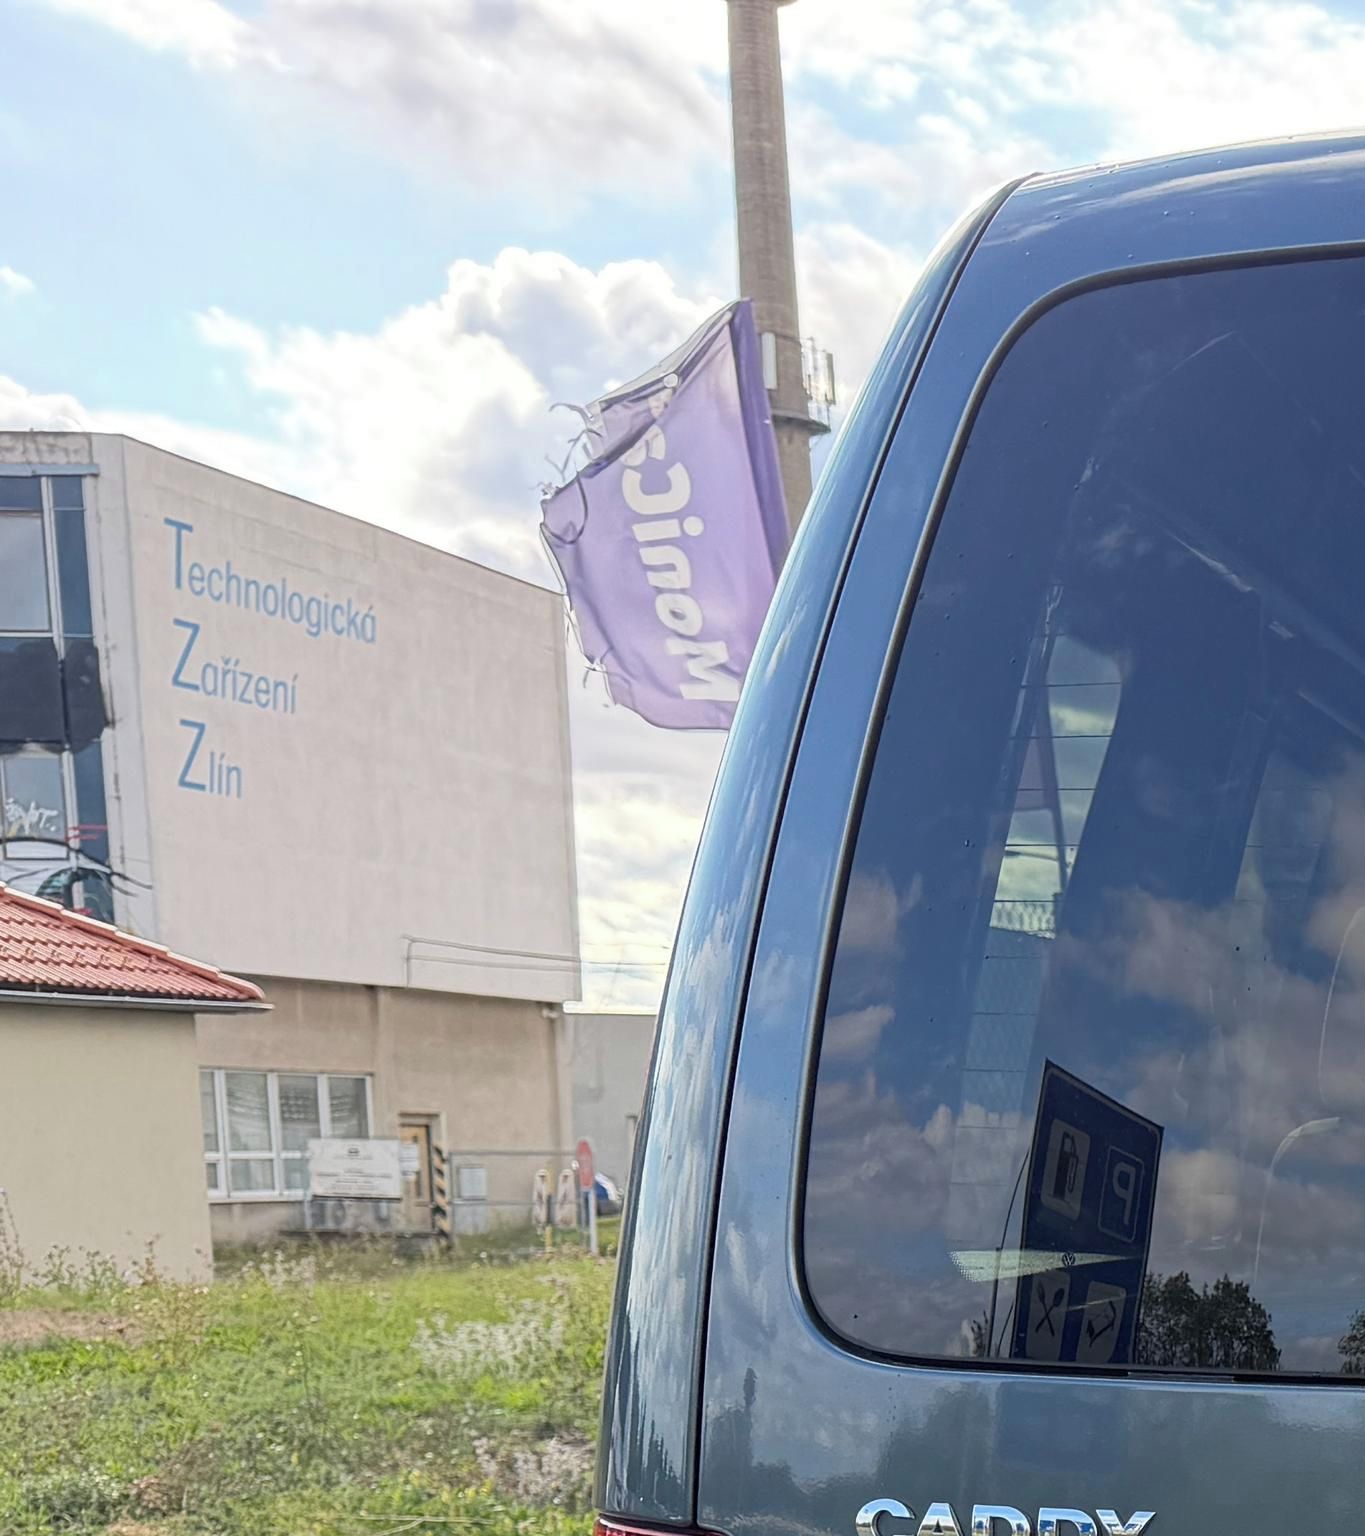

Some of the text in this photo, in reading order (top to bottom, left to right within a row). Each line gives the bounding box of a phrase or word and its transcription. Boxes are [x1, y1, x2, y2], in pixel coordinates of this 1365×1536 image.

[164, 517, 377, 645] Technologická
[171, 618, 298, 715] Zařízení
[178, 719, 243, 799] Zlín
